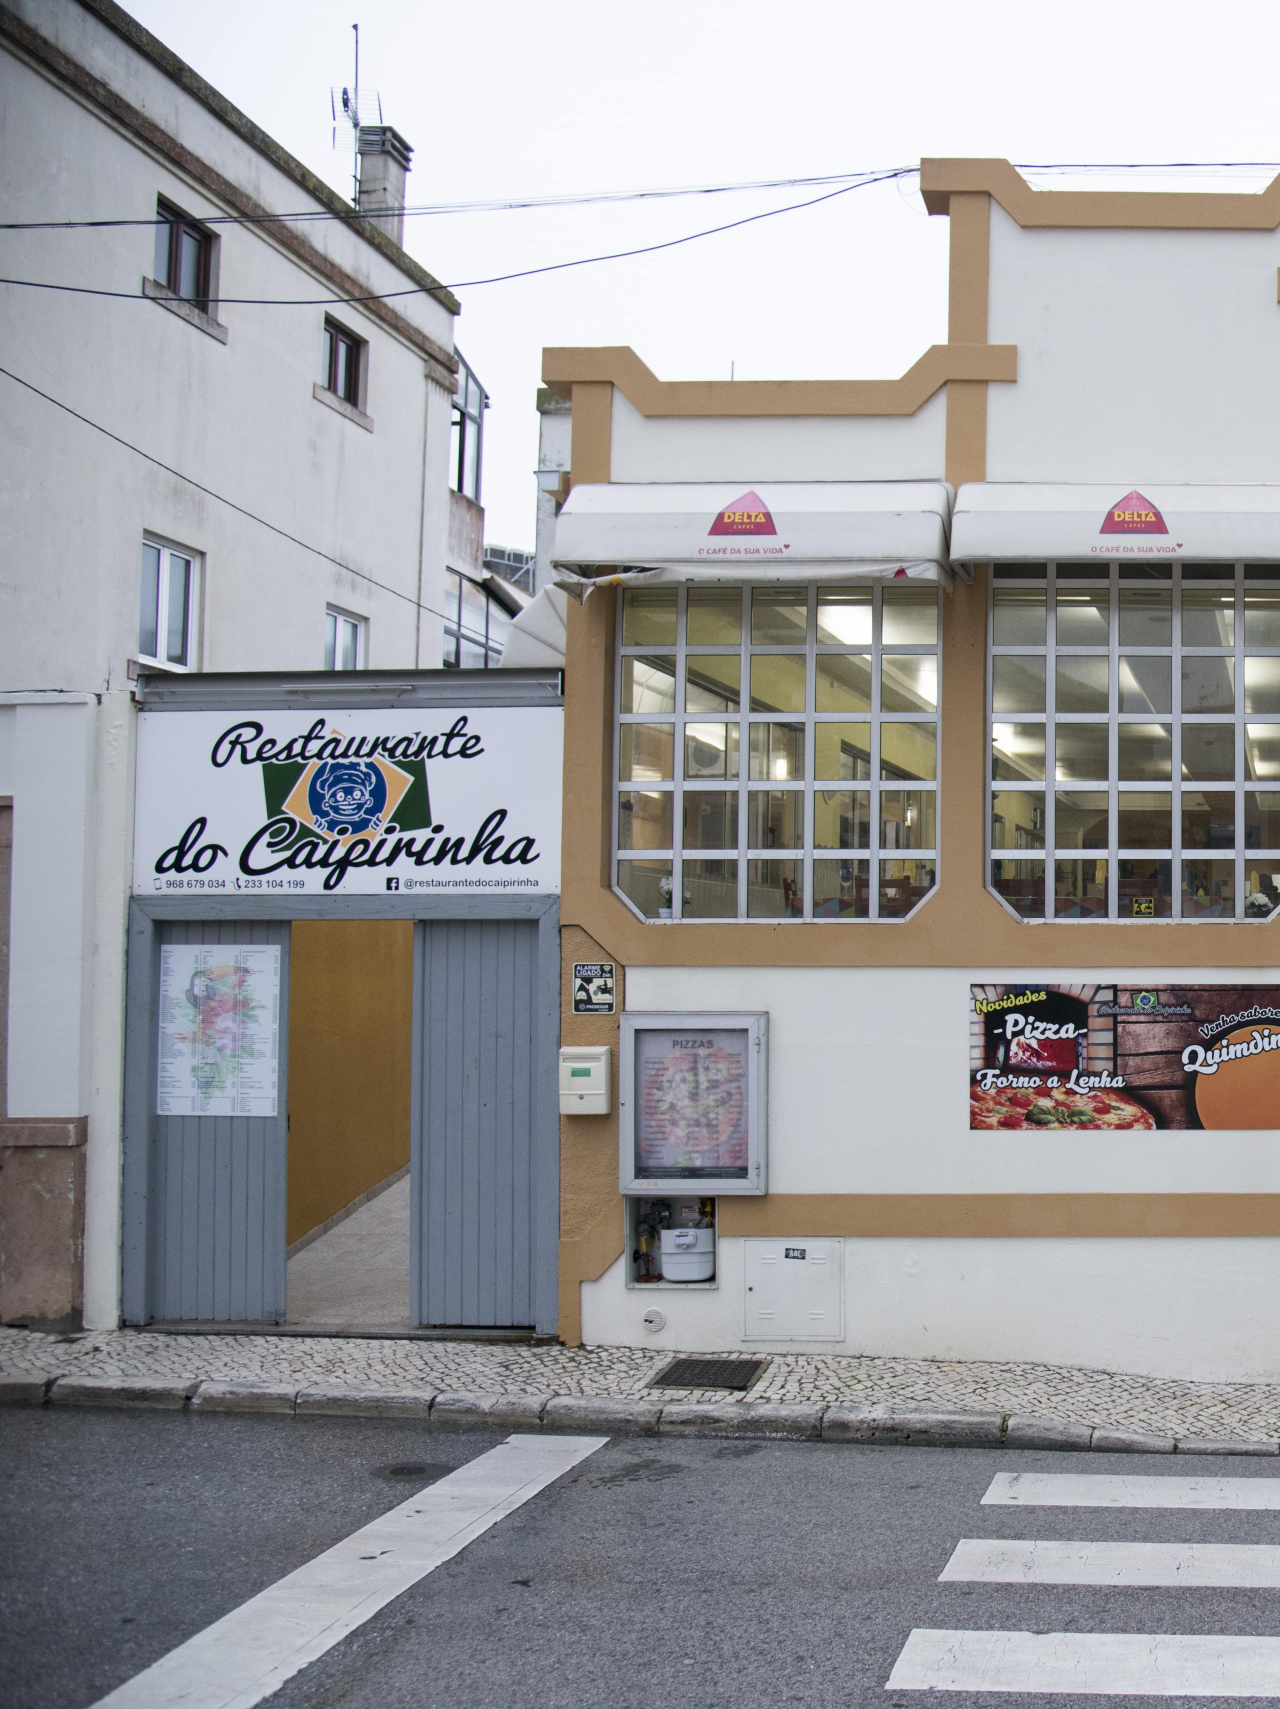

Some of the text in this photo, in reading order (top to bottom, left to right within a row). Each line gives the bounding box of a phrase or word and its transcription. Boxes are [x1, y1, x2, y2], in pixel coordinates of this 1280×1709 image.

[723, 512, 766, 523] DELTA
[1114, 511, 1157, 522] DELTA
[706, 547, 728, 555] CAFÉ
[1099, 545, 1121, 553] CAFÉ
[210, 715, 486, 769] Restaurante
[154, 808, 541, 891] do Caipirinha
[165, 880, 226, 889] 968 679 034
[244, 880, 305, 889] 233 104 199
[403, 878, 539, 890] @restaurantedocaipirinha
[975, 990, 1047, 1015] Novidades
[1198, 1015, 1239, 1039] Venha
[672, 1040, 714, 1049] PIZZAS
[975, 1068, 1127, 1095] Forno a Lenha
